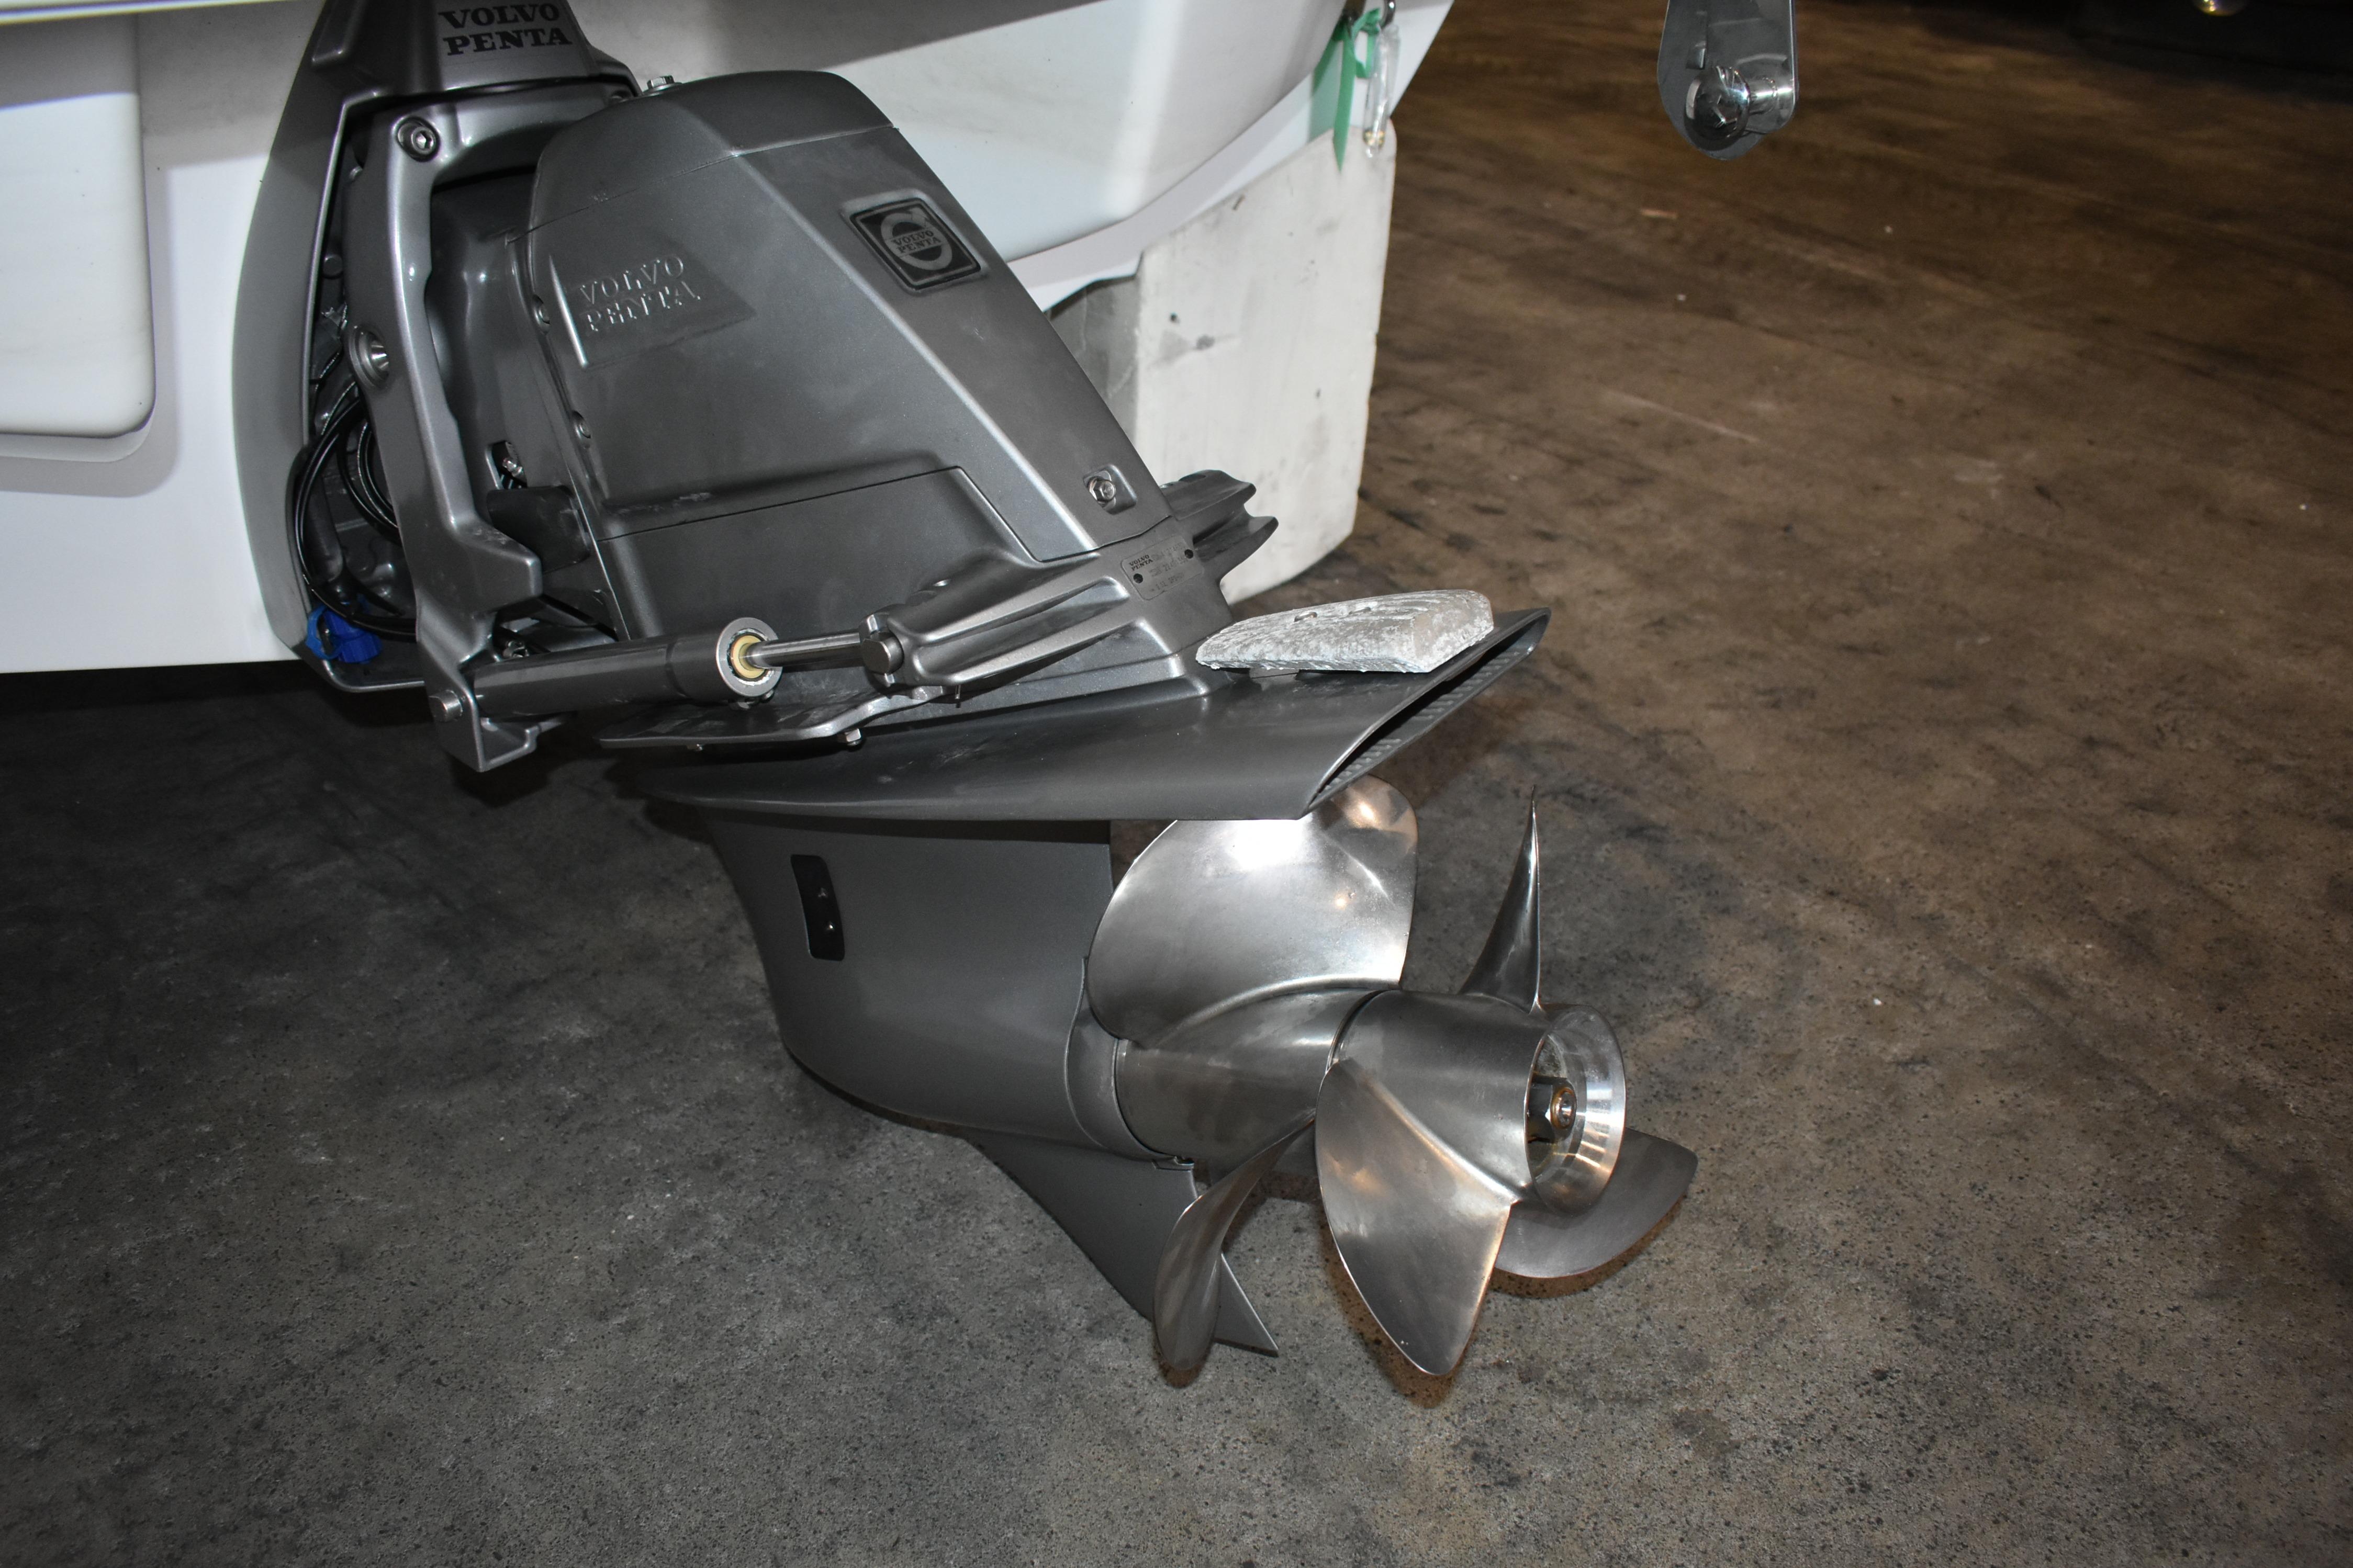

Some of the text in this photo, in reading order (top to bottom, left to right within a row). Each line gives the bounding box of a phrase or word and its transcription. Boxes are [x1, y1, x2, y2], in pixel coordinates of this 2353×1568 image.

[438, 3, 559, 29] VOLVO
[443, 28, 573, 55] PENTA
[891, 230, 934, 246] VOLVO
[896, 236, 942, 254] PENTA
[579, 255, 684, 304] VOLVO
[581, 280, 701, 332] PENTA
[1129, 554, 1150, 566] VOLVO
[1131, 558, 1153, 571] PENTA
